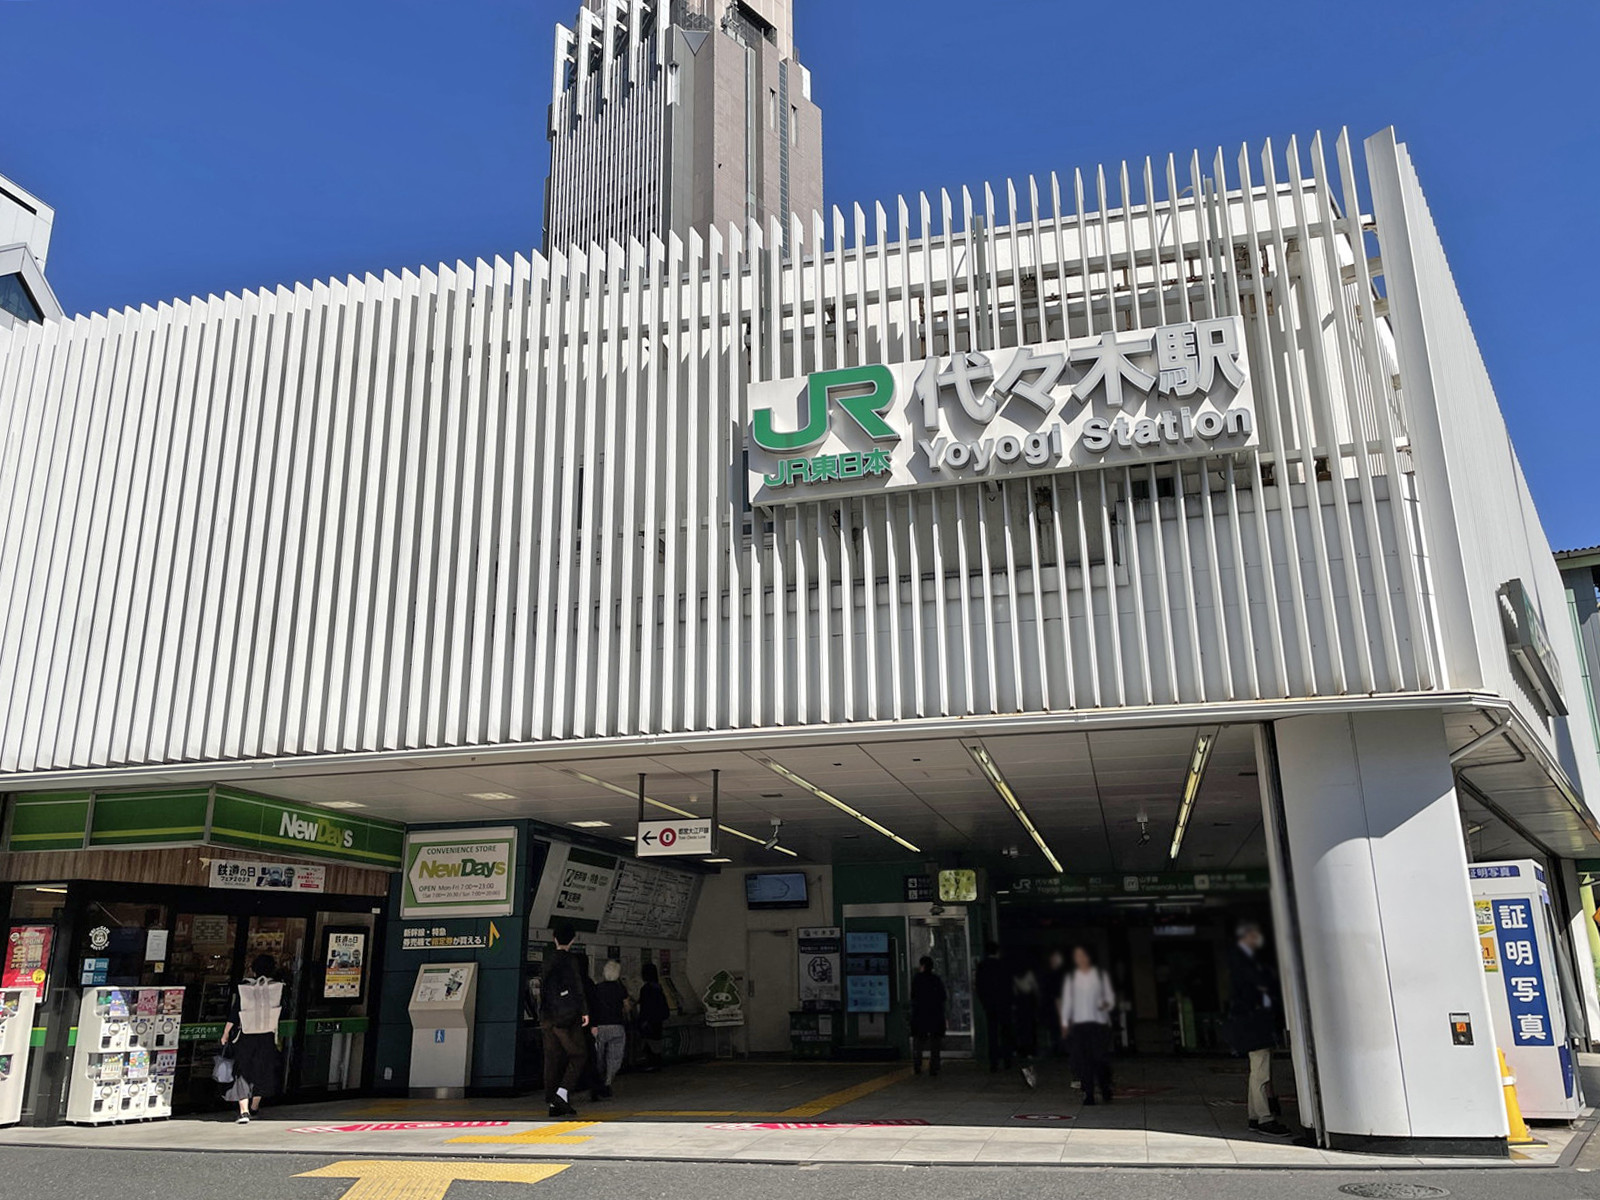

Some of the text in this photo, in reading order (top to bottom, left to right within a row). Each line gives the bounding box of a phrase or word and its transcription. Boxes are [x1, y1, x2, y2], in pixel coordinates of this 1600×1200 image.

[913, 318, 1246, 431] 代々木駅
[752, 363, 899, 451] JR
[919, 405, 1253, 474] Yoyogi Station
[764, 448, 893, 487] JR東日本
[279, 811, 354, 849] NewDays
[217, 863, 257, 877] 鉄道の日
[418, 858, 506, 879] NewDays
[427, 845, 497, 856] CONVENIENCE STORE
[1498, 905, 1546, 1040] 証明写真
